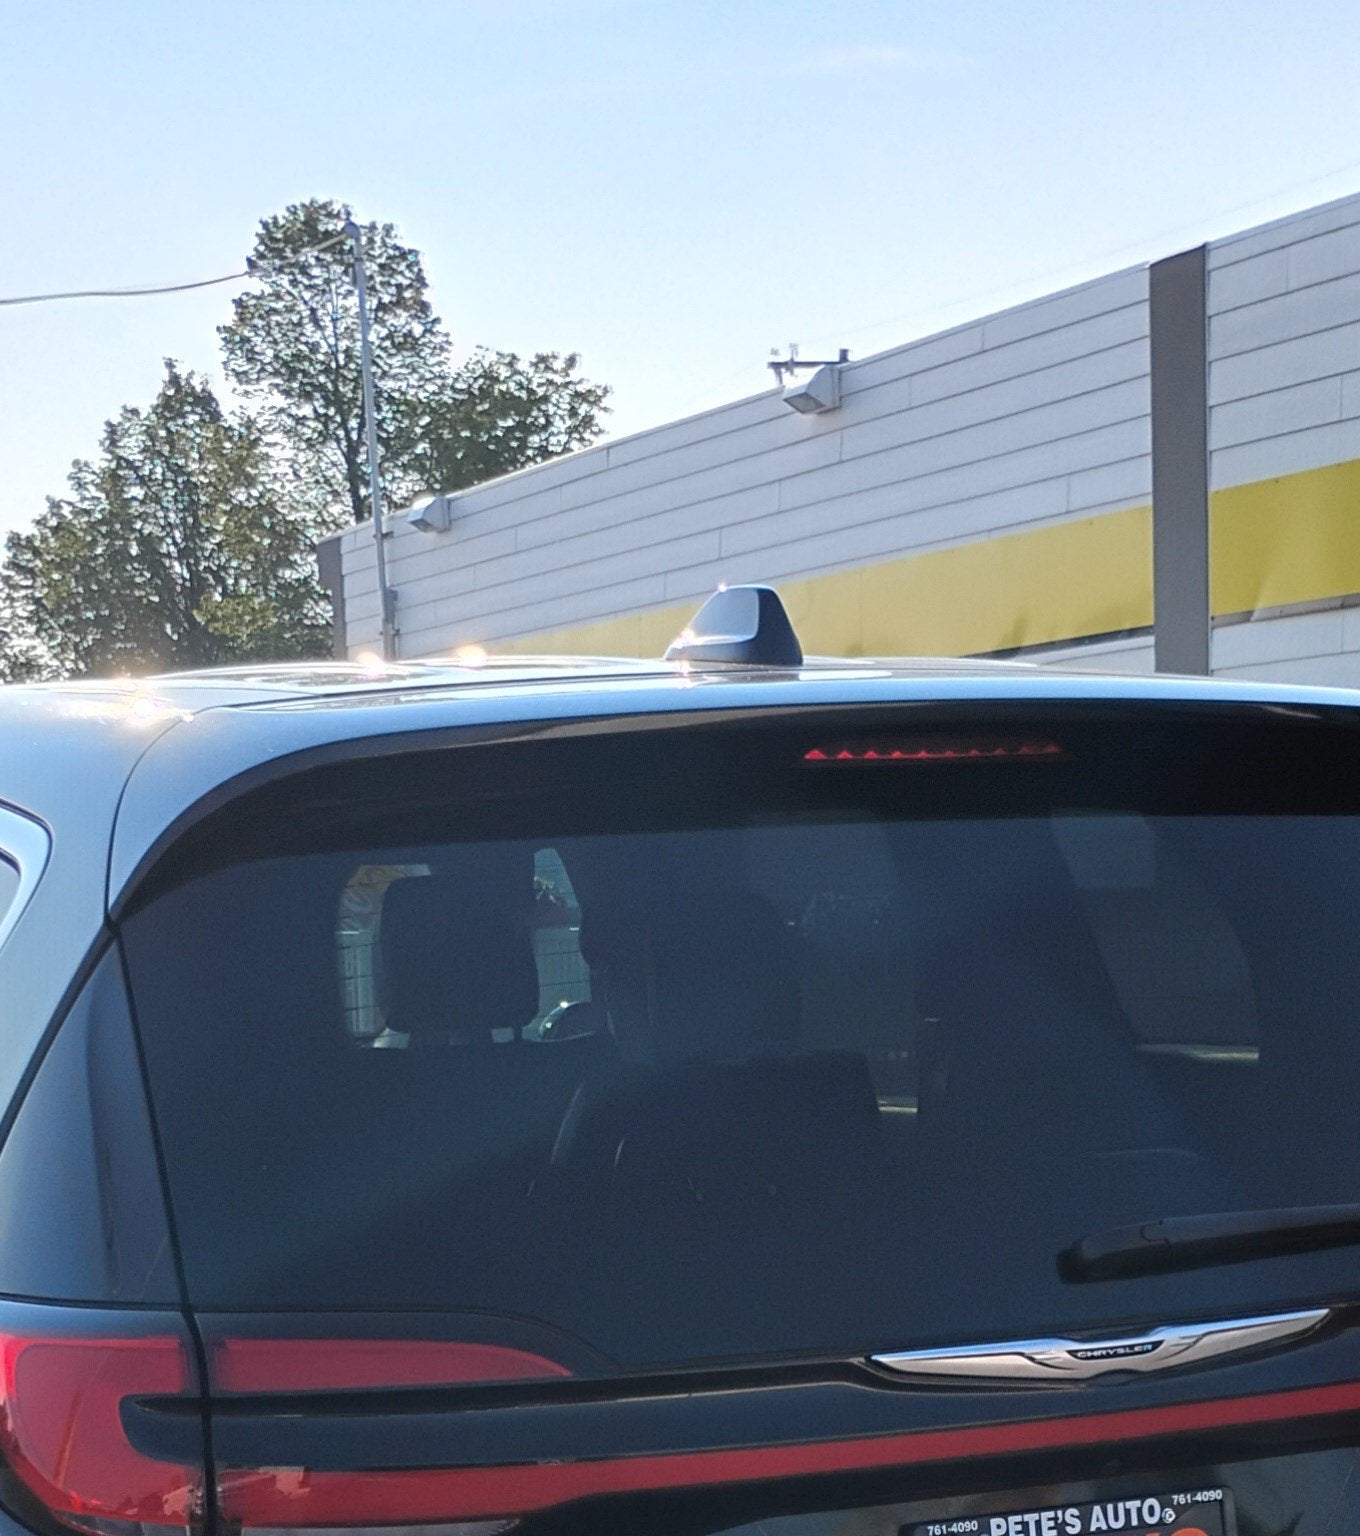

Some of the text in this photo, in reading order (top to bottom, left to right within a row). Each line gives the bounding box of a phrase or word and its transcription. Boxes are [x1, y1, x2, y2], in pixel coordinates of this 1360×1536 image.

[1077, 1344, 1153, 1358] CHRYSLER
[1171, 1489, 1223, 1506] 761-4090
[1090, 1498, 1161, 1532] AUTO
[927, 1520, 978, 1536] 761-4090
